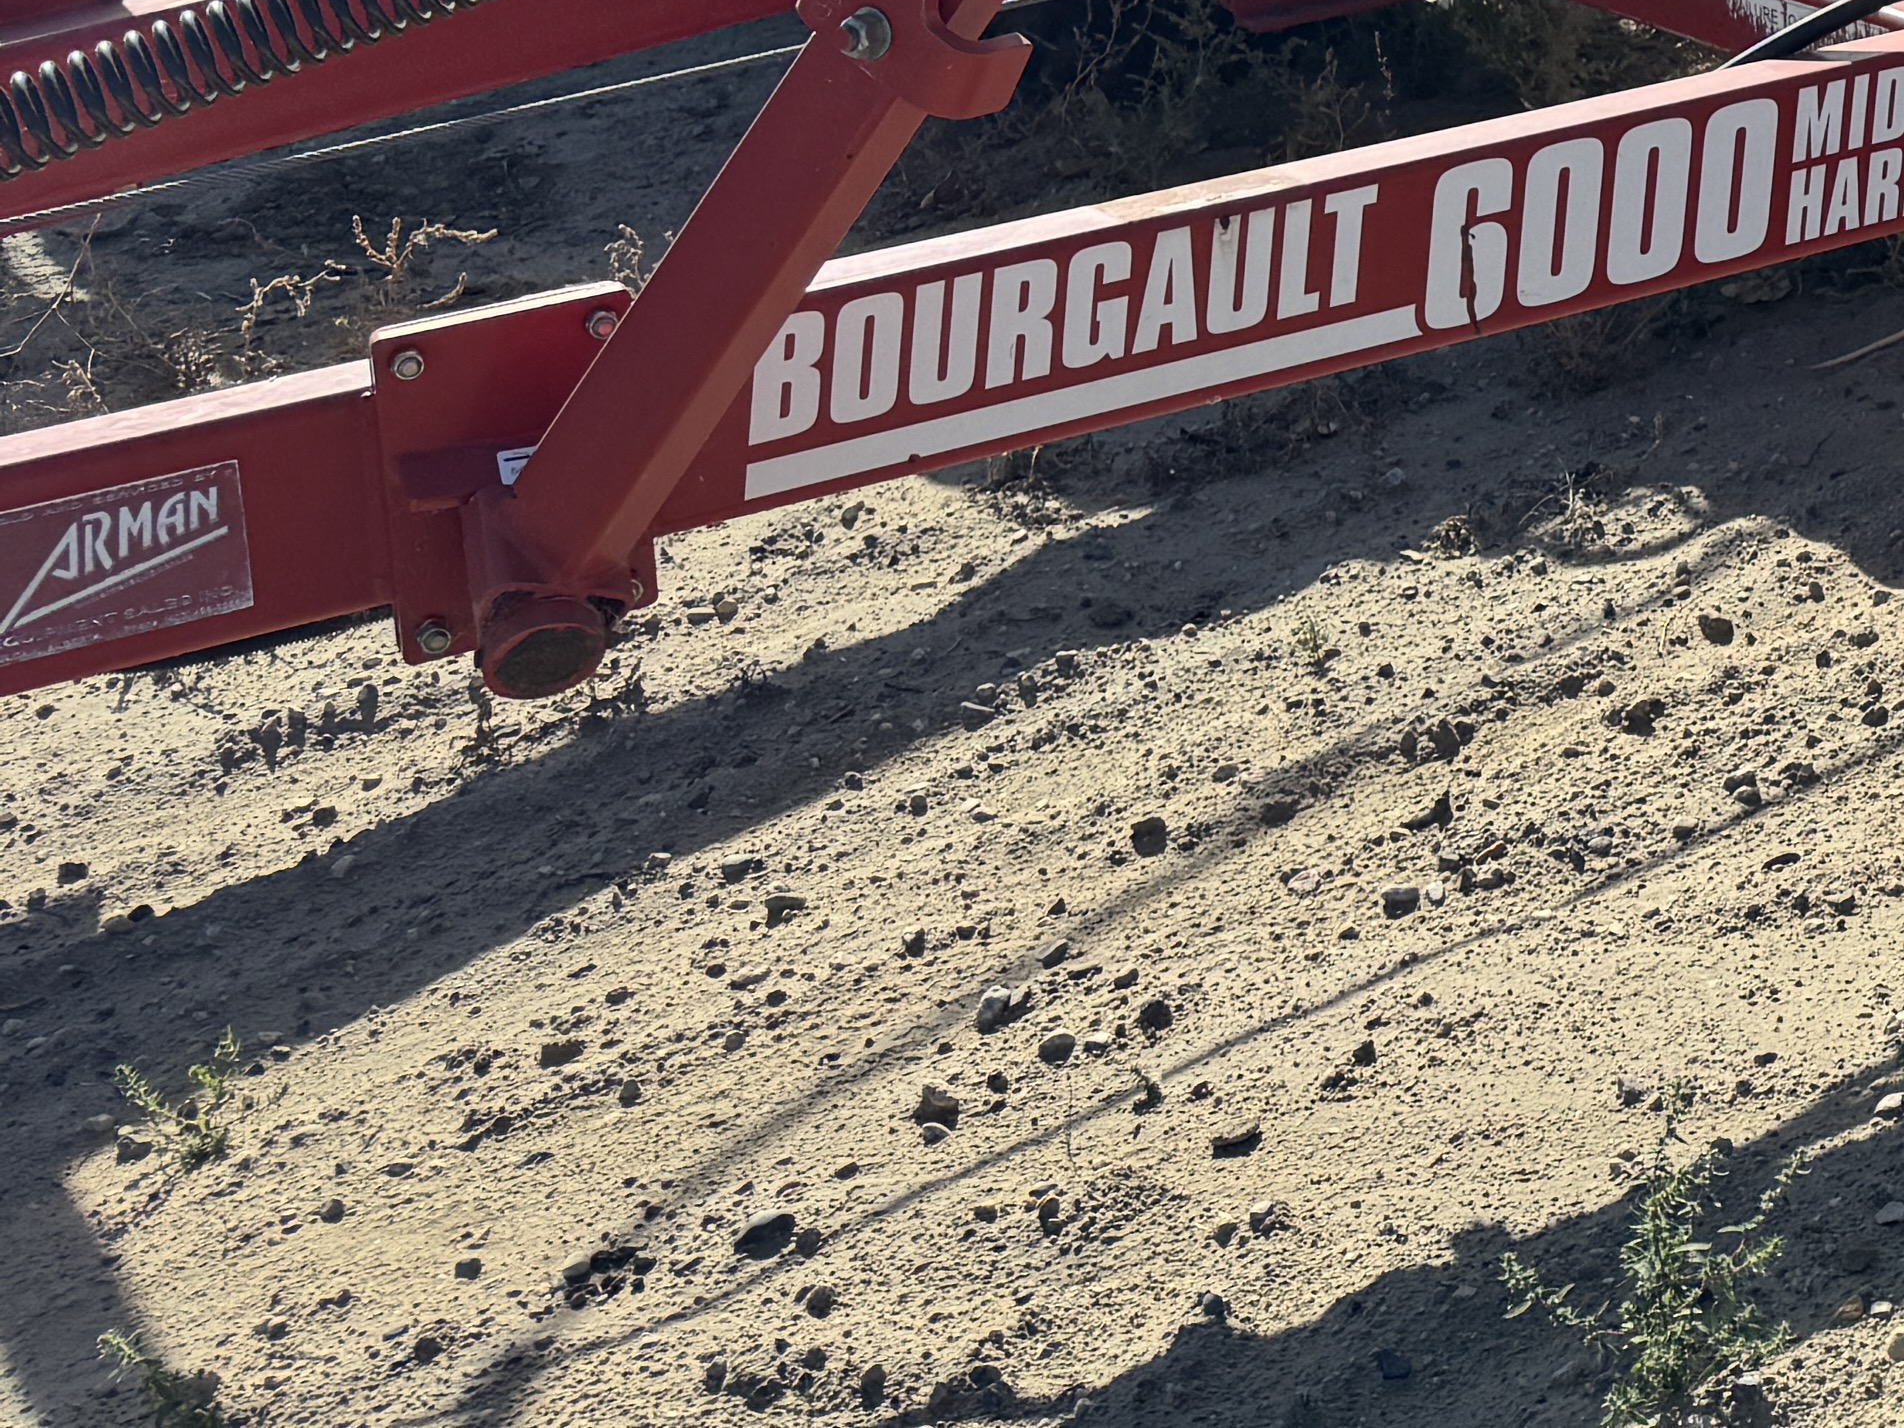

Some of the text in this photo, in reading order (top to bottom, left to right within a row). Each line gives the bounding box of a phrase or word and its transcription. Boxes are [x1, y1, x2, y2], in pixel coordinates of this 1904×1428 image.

[749, 98, 1779, 446] BOURGAULT 6000
[12, 485, 218, 614] ARMAN
